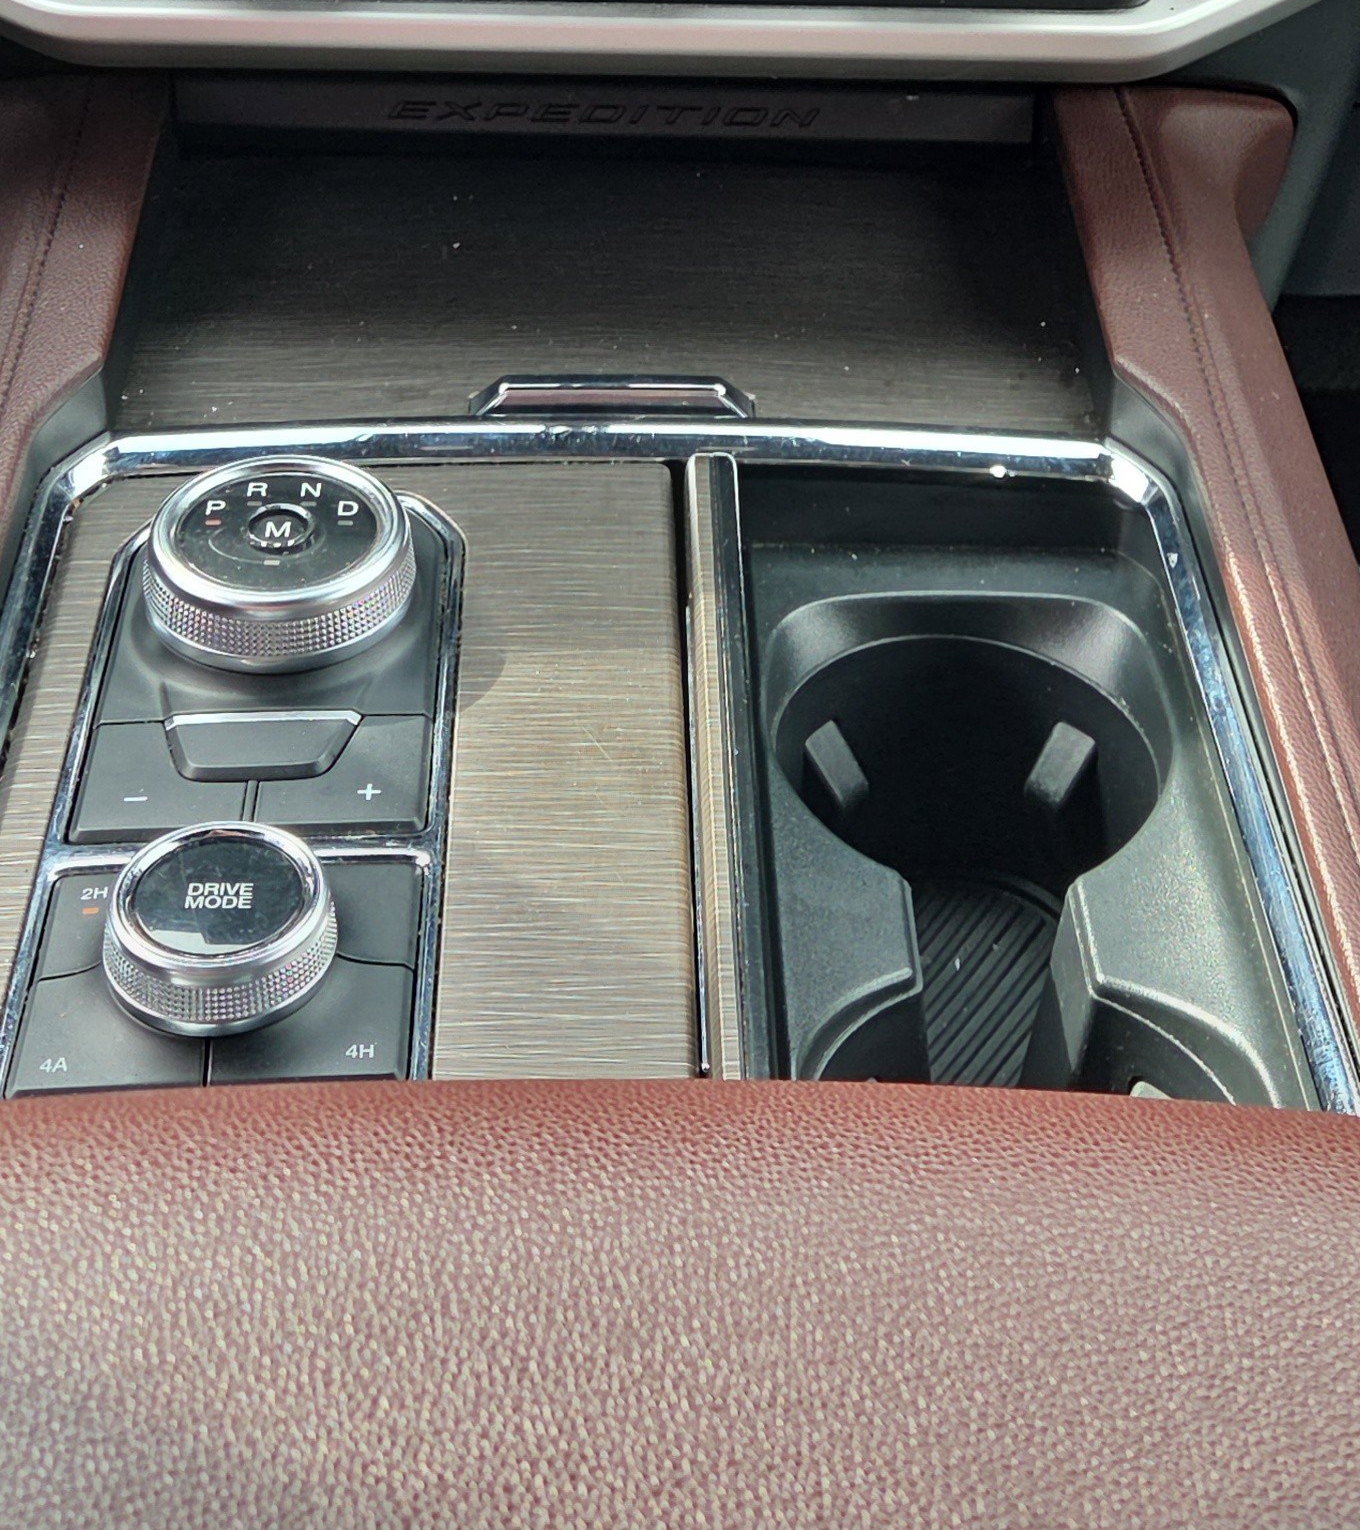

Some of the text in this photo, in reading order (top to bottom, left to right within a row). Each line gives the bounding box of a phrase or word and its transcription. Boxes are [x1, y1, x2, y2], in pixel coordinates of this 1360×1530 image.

[387, 99, 822, 128] EXPEDITION
[246, 481, 269, 498] R
[299, 482, 323, 499] N
[204, 499, 228, 517] P
[336, 500, 360, 517] D
[263, 520, 293, 540] M
[80, 887, 109, 901] 2H
[187, 881, 254, 897] DRIVE
[184, 894, 252, 910] MODE
[345, 1043, 375, 1059] 4H
[39, 1056, 68, 1073] 4A
